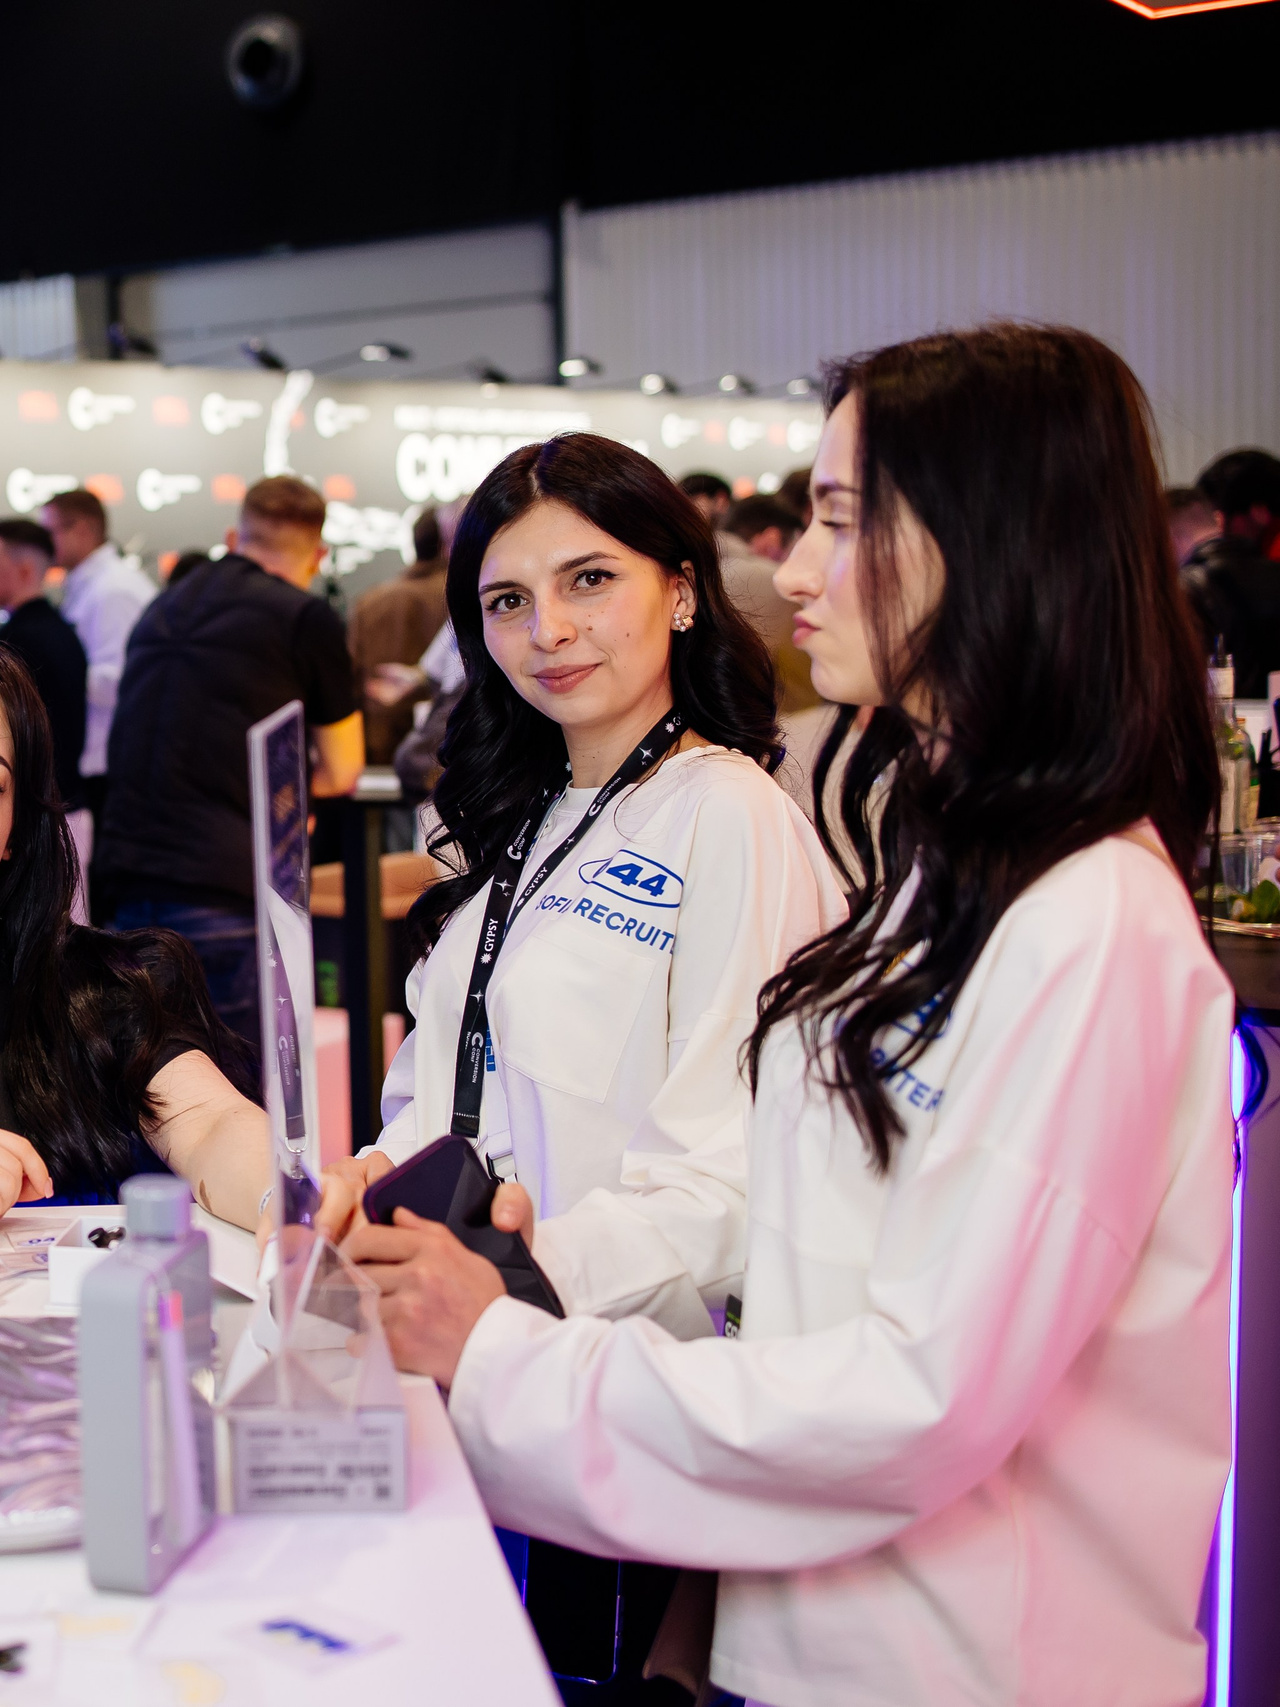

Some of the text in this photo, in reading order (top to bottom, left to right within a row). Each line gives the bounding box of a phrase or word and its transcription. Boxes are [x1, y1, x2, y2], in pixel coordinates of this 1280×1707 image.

[524, 866, 548, 896] GYPSY
[605, 862, 668, 897] 44
[484, 917, 499, 952] GYPSY
[572, 897, 675, 955] RECRUIT
[471, 1048, 481, 1084] CONVERSION
